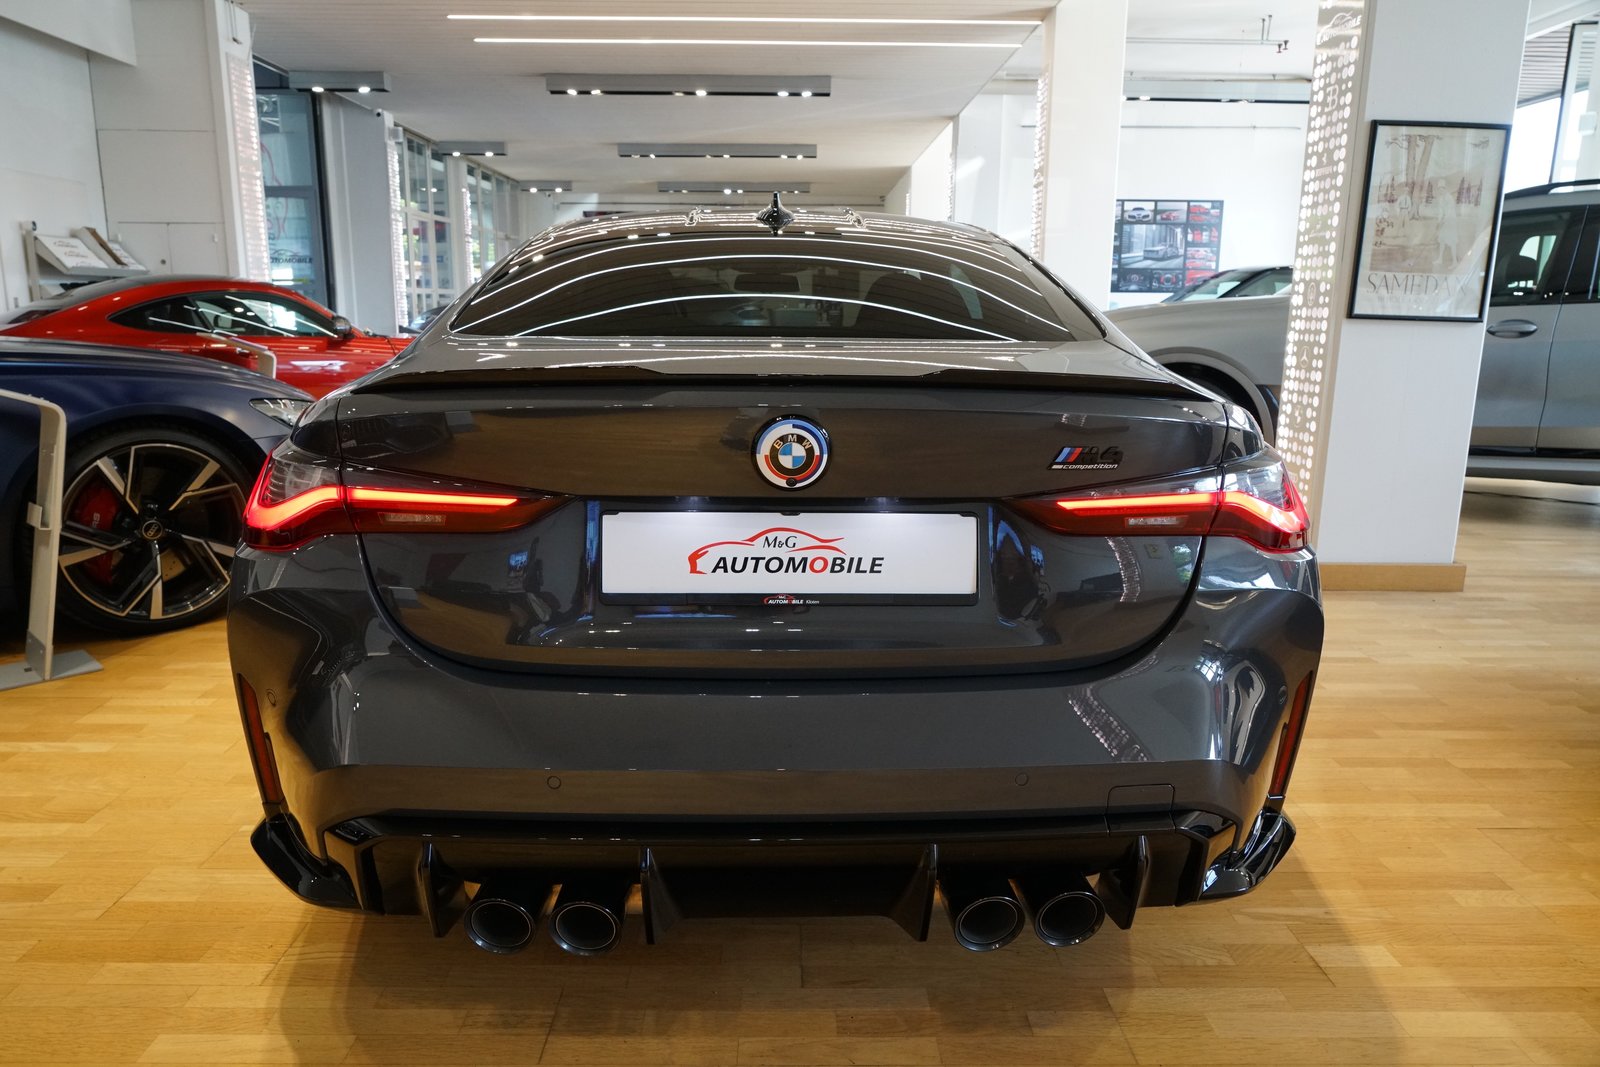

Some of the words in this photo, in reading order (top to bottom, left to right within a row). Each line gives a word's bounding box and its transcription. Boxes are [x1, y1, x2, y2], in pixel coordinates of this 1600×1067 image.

[269, 256, 313, 264] TOMOBILE
[773, 434, 812, 449] BMW
[762, 535, 798, 549] M&G
[711, 556, 884, 574] AUTOMOBILE
